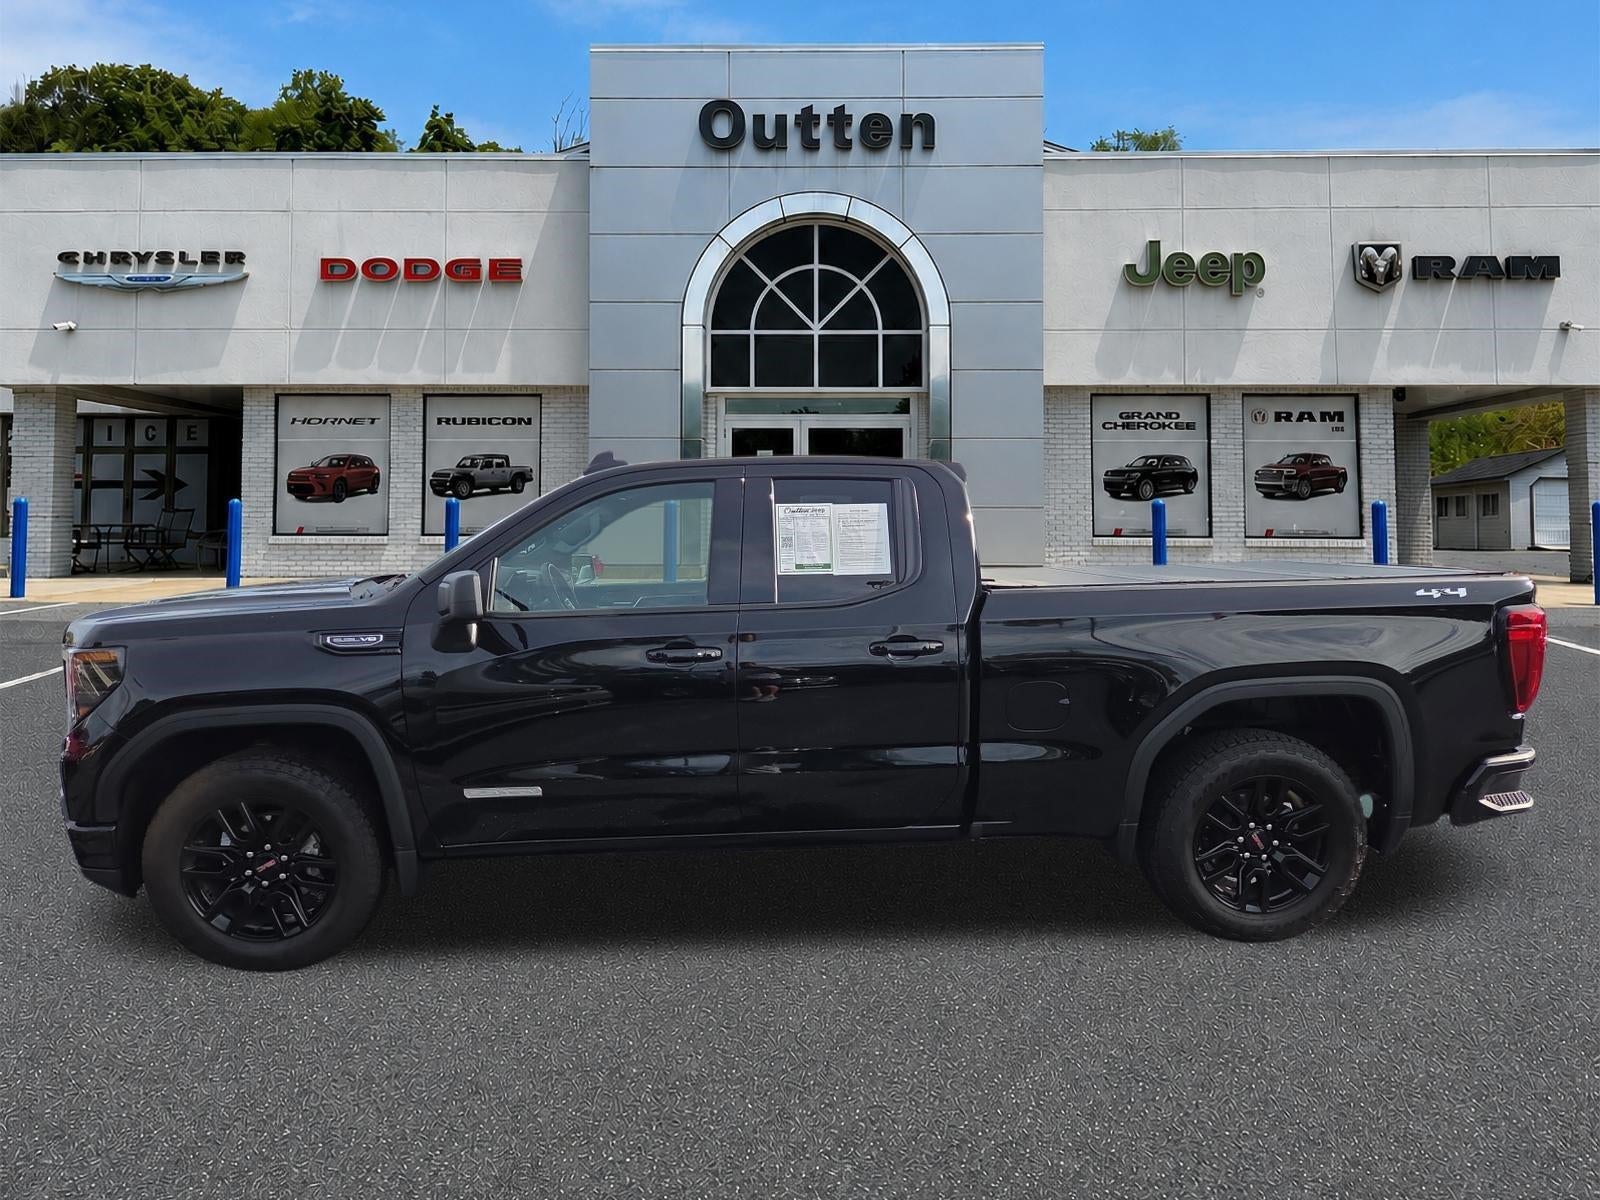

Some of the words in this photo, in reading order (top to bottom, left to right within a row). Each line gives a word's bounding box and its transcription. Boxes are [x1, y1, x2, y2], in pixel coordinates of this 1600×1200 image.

[699, 99, 936, 150] Outten
[57, 251, 247, 266] CHRYSLER
[320, 258, 524, 283] DODGE
[1123, 240, 1266, 296] Jeep
[1411, 255, 1561, 280] RAM
[290, 417, 381, 426] HORNET
[436, 416, 533, 426] RUBICON
[1118, 411, 1180, 420] GRAND
[1274, 411, 1345, 423] RAM
[1102, 421, 1196, 431] CHEROKEE
